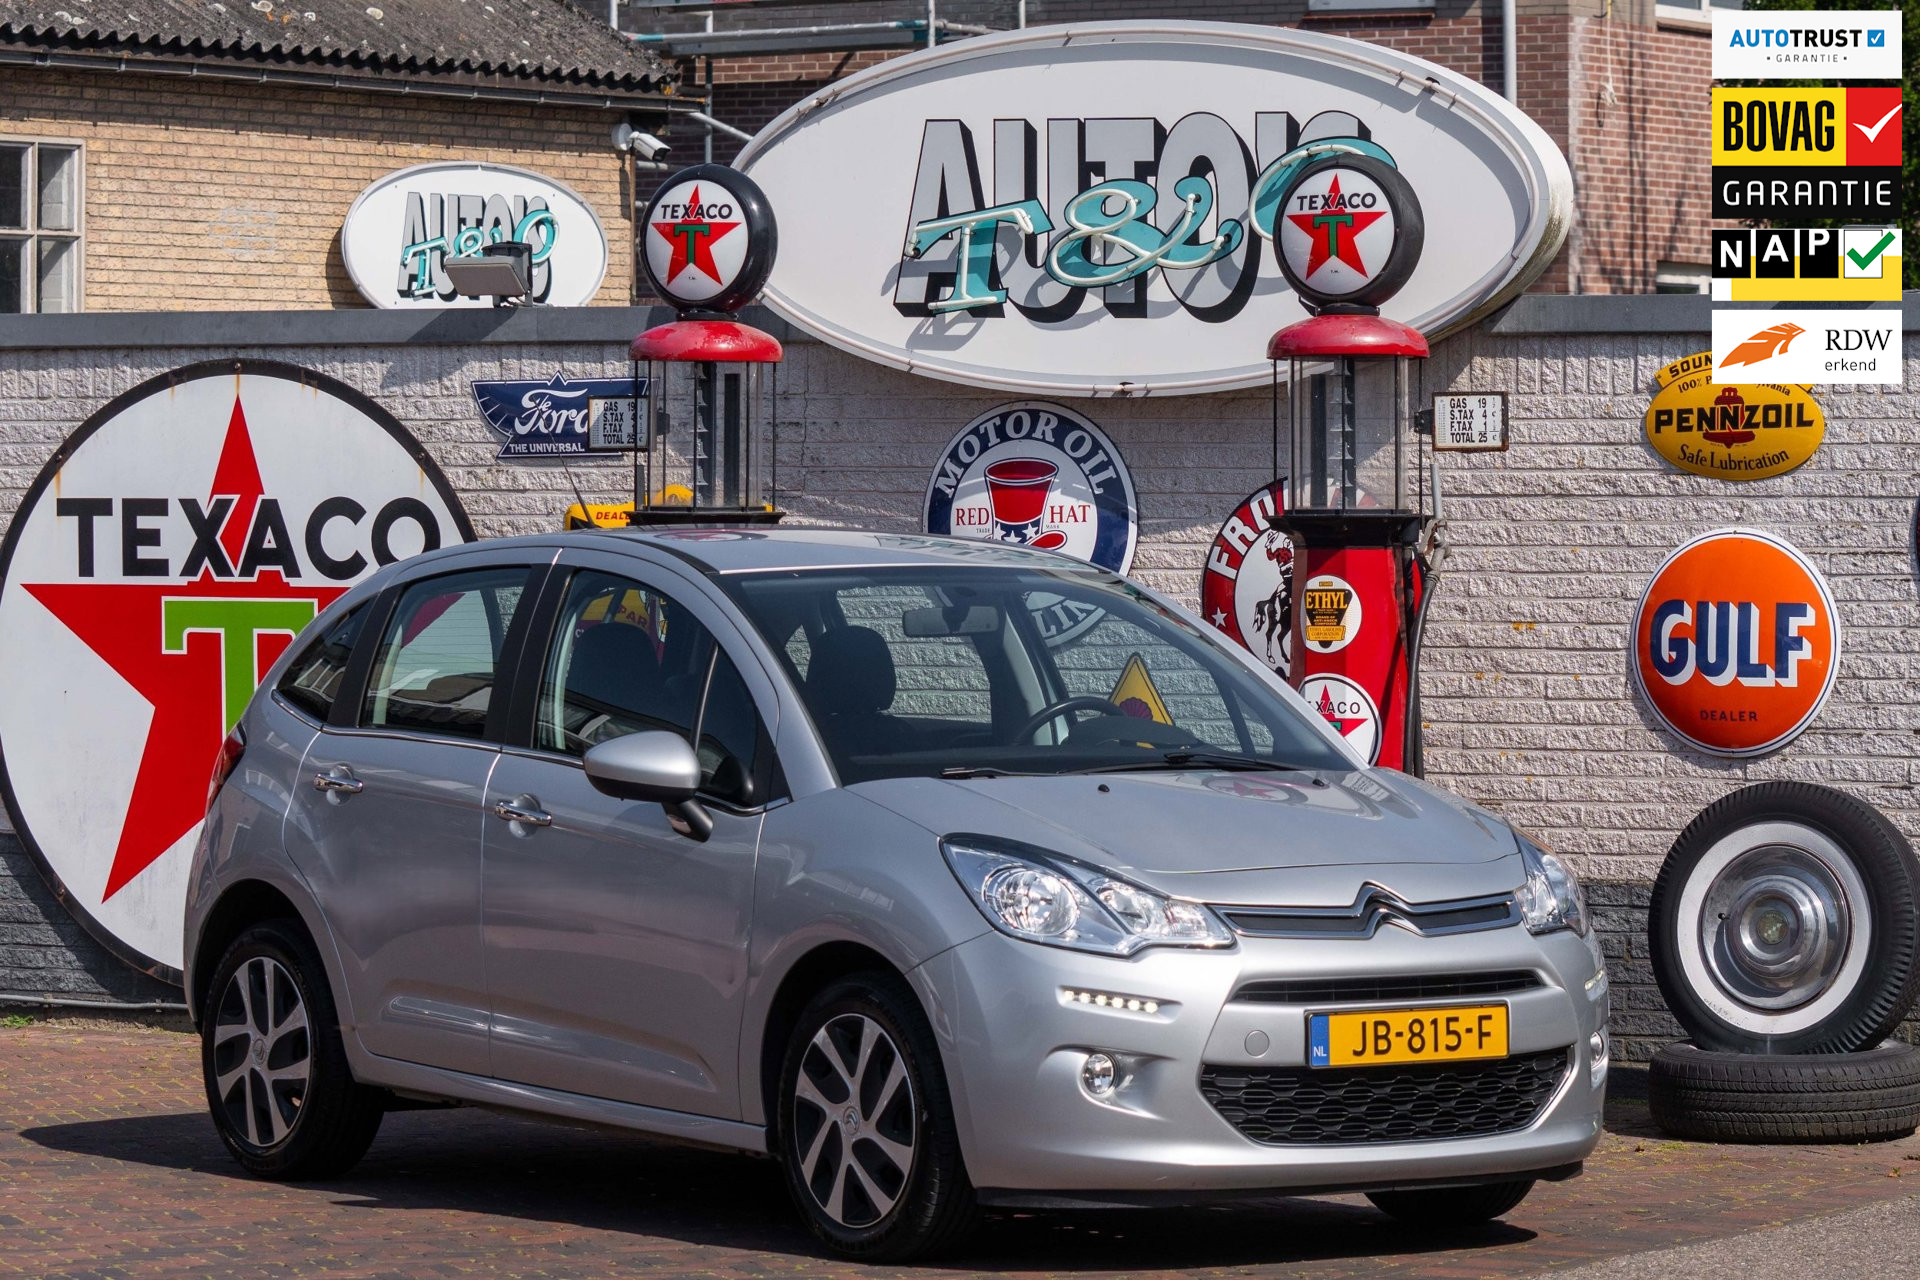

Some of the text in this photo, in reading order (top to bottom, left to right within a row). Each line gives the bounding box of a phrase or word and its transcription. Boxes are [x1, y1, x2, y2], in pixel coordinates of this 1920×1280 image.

[1296, 192, 1377, 211] TEXACO
[660, 203, 734, 220] TEXACO
[1669, 353, 1713, 379] SOUN
[603, 401, 619, 412] GAS
[1450, 398, 1467, 408] GAS
[1478, 398, 1487, 408] 19
[603, 412, 624, 423] S.TAX
[1450, 409, 1474, 420] S.TAX
[1482, 409, 1487, 420] 4
[1655, 402, 1815, 434] PENNZOIL
[603, 423, 623, 433] F.TAX
[1450, 421, 1473, 432] F.TAX
[1483, 421, 1487, 431] 1
[603, 434, 625, 444] TOTAL
[1450, 432, 1475, 443] TOTAL
[1478, 432, 1488, 443] 25
[509, 443, 585, 453] THE UNIVERSAL
[935, 411, 1117, 498] MOTOR OIL
[1677, 443, 1790, 471] Safe Lubrication
[955, 504, 1091, 526] RED HAT
[56, 496, 441, 581] TEXACO
[1306, 591, 1348, 609] ETHYL
[1651, 599, 1816, 688] GULF
[1308, 700, 1361, 714] XACO
[1700, 709, 1758, 721] DEALER
[1352, 1014, 1493, 1057] JB-815-F
[1313, 1046, 1327, 1057] NL
